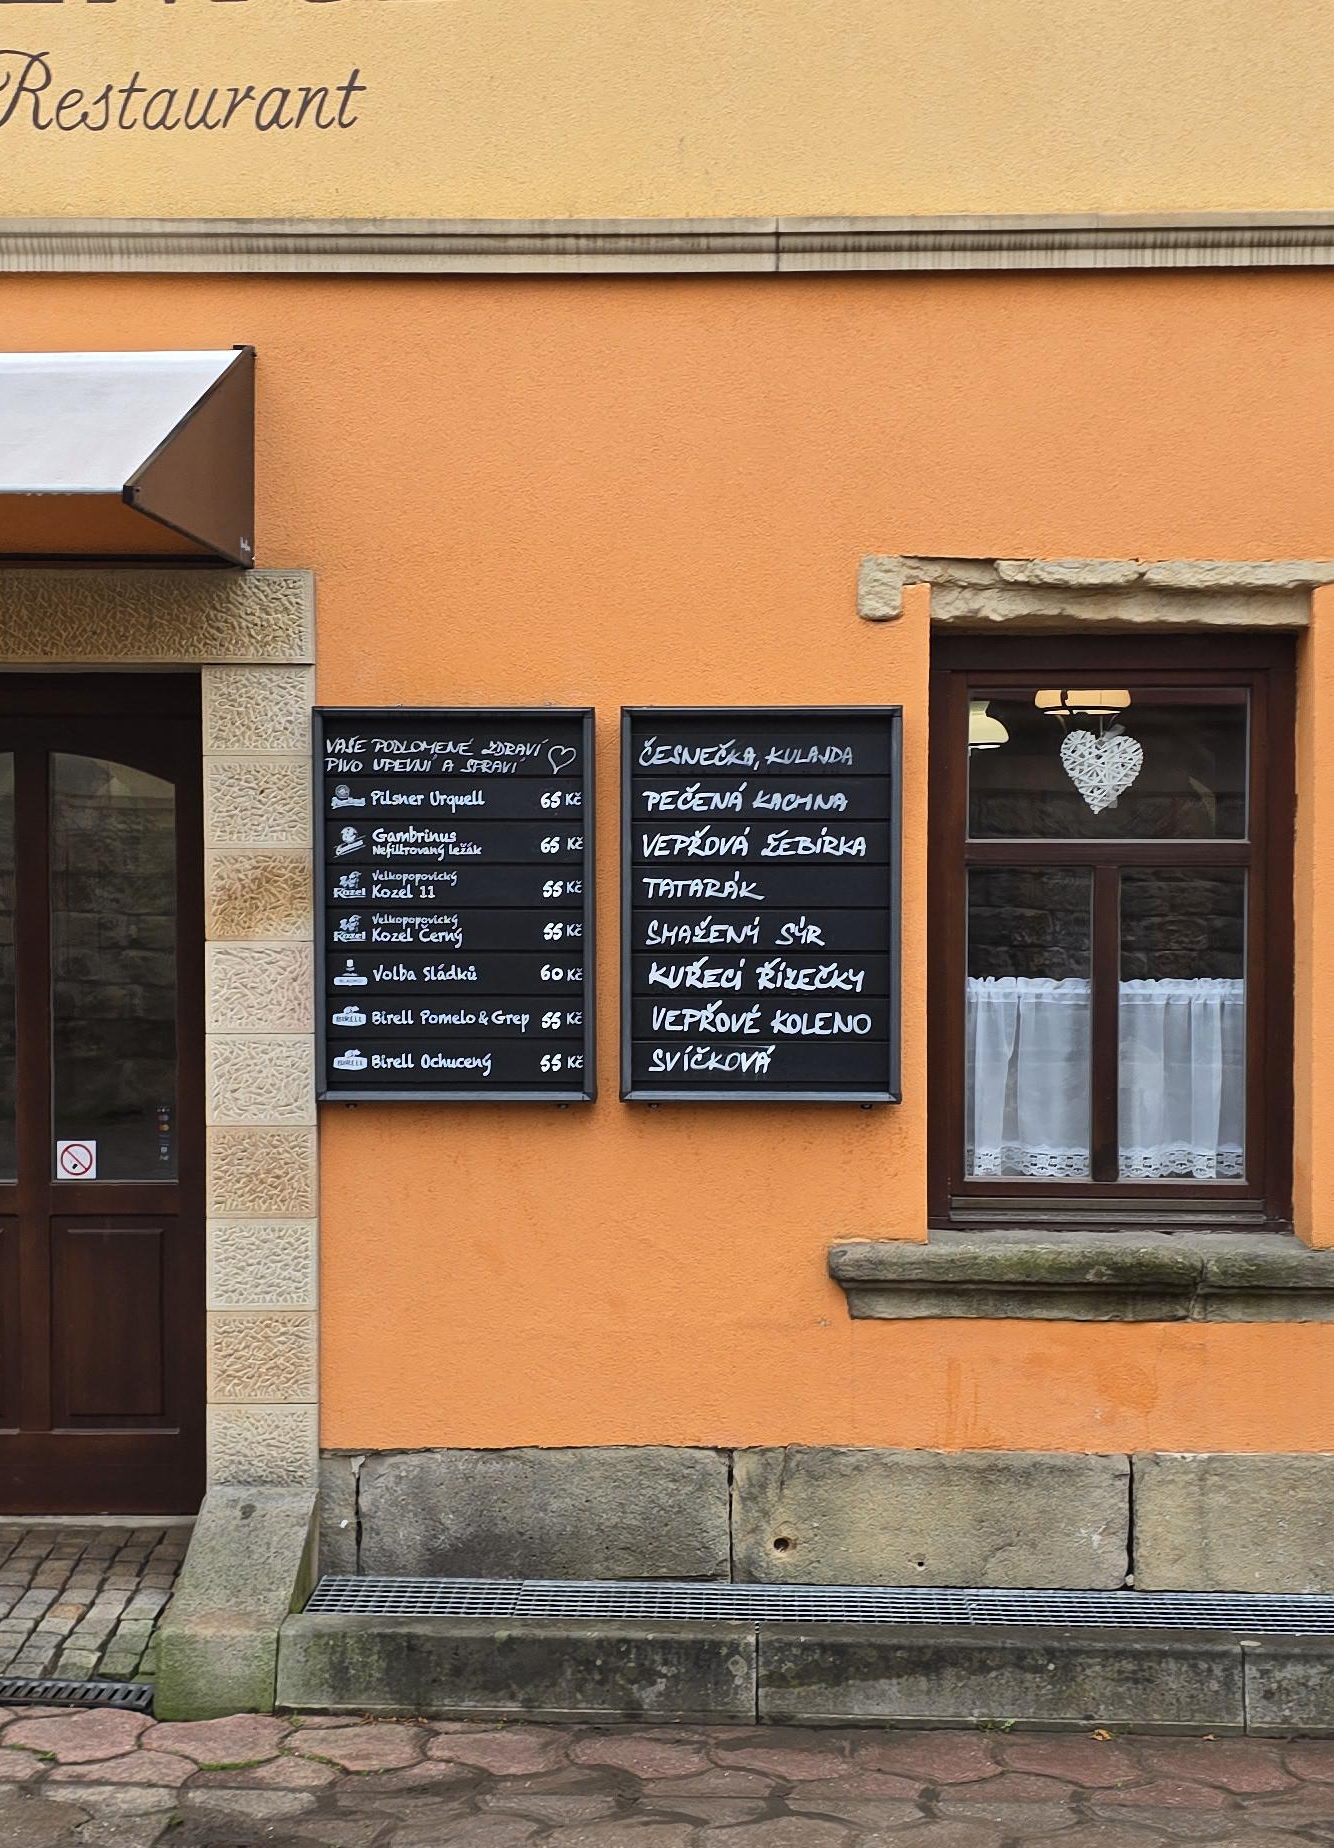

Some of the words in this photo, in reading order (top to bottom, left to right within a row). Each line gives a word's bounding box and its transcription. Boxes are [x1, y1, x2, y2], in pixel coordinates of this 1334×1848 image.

[326, 735, 368, 754] VAŠE
[370, 738, 474, 756] PODLOMENÉ
[481, 738, 549, 757] ZDRAVÍ
[324, 758, 363, 773] PIVO
[373, 755, 437, 773] UPEVNÍ
[442, 759, 454, 773] A
[460, 757, 526, 774] SPRAVÍ
[370, 791, 424, 806] Pilsner
[429, 790, 486, 813] Urquell
[540, 792, 562, 809] 65
[565, 792, 582, 806] Kč
[642, 781, 748, 812] PEČENÁ
[752, 790, 849, 812] KACHNA
[371, 826, 457, 843] Gambrinus
[642, 824, 751, 857] VEPŘOVÁ
[372, 843, 445, 861] Nefiltrovaný
[449, 842, 482, 856] ležák
[540, 837, 561, 854] 65
[567, 836, 584, 850] Kč
[371, 884, 413, 899] Kozel
[419, 886, 436, 899] 11
[542, 880, 563, 898] 55
[566, 880, 582, 894] Kč
[372, 869, 458, 886] Velkopopovický
[642, 870, 766, 901] TATARÁK
[372, 913, 459, 930] Velkopopovický
[645, 915, 760, 947] SMAŽENÝ
[775, 915, 826, 947] SÝR
[371, 927, 413, 942] Kozel
[419, 925, 463, 948] Černý
[543, 923, 563, 941] 55
[566, 924, 582, 937] Kč
[373, 964, 417, 982] Volba
[423, 964, 478, 982] Sládků
[540, 964, 563, 981] 60
[567, 968, 583, 982] Kč
[648, 956, 746, 991] KUŘECÍ
[755, 957, 866, 992] ŘÍZEČKY
[371, 1010, 414, 1025] Birell
[541, 1011, 562, 1030] 55
[566, 1011, 583, 1025] Kč
[652, 999, 762, 1034] VEPŘOVÉ
[770, 1009, 872, 1035] KOLENO
[371, 1053, 415, 1069] Birell
[420, 1053, 493, 1077] Ochucený
[540, 1054, 562, 1073] 55
[567, 1055, 584, 1069] Kč
[648, 1044, 776, 1074] SVÍČKOVÁ
